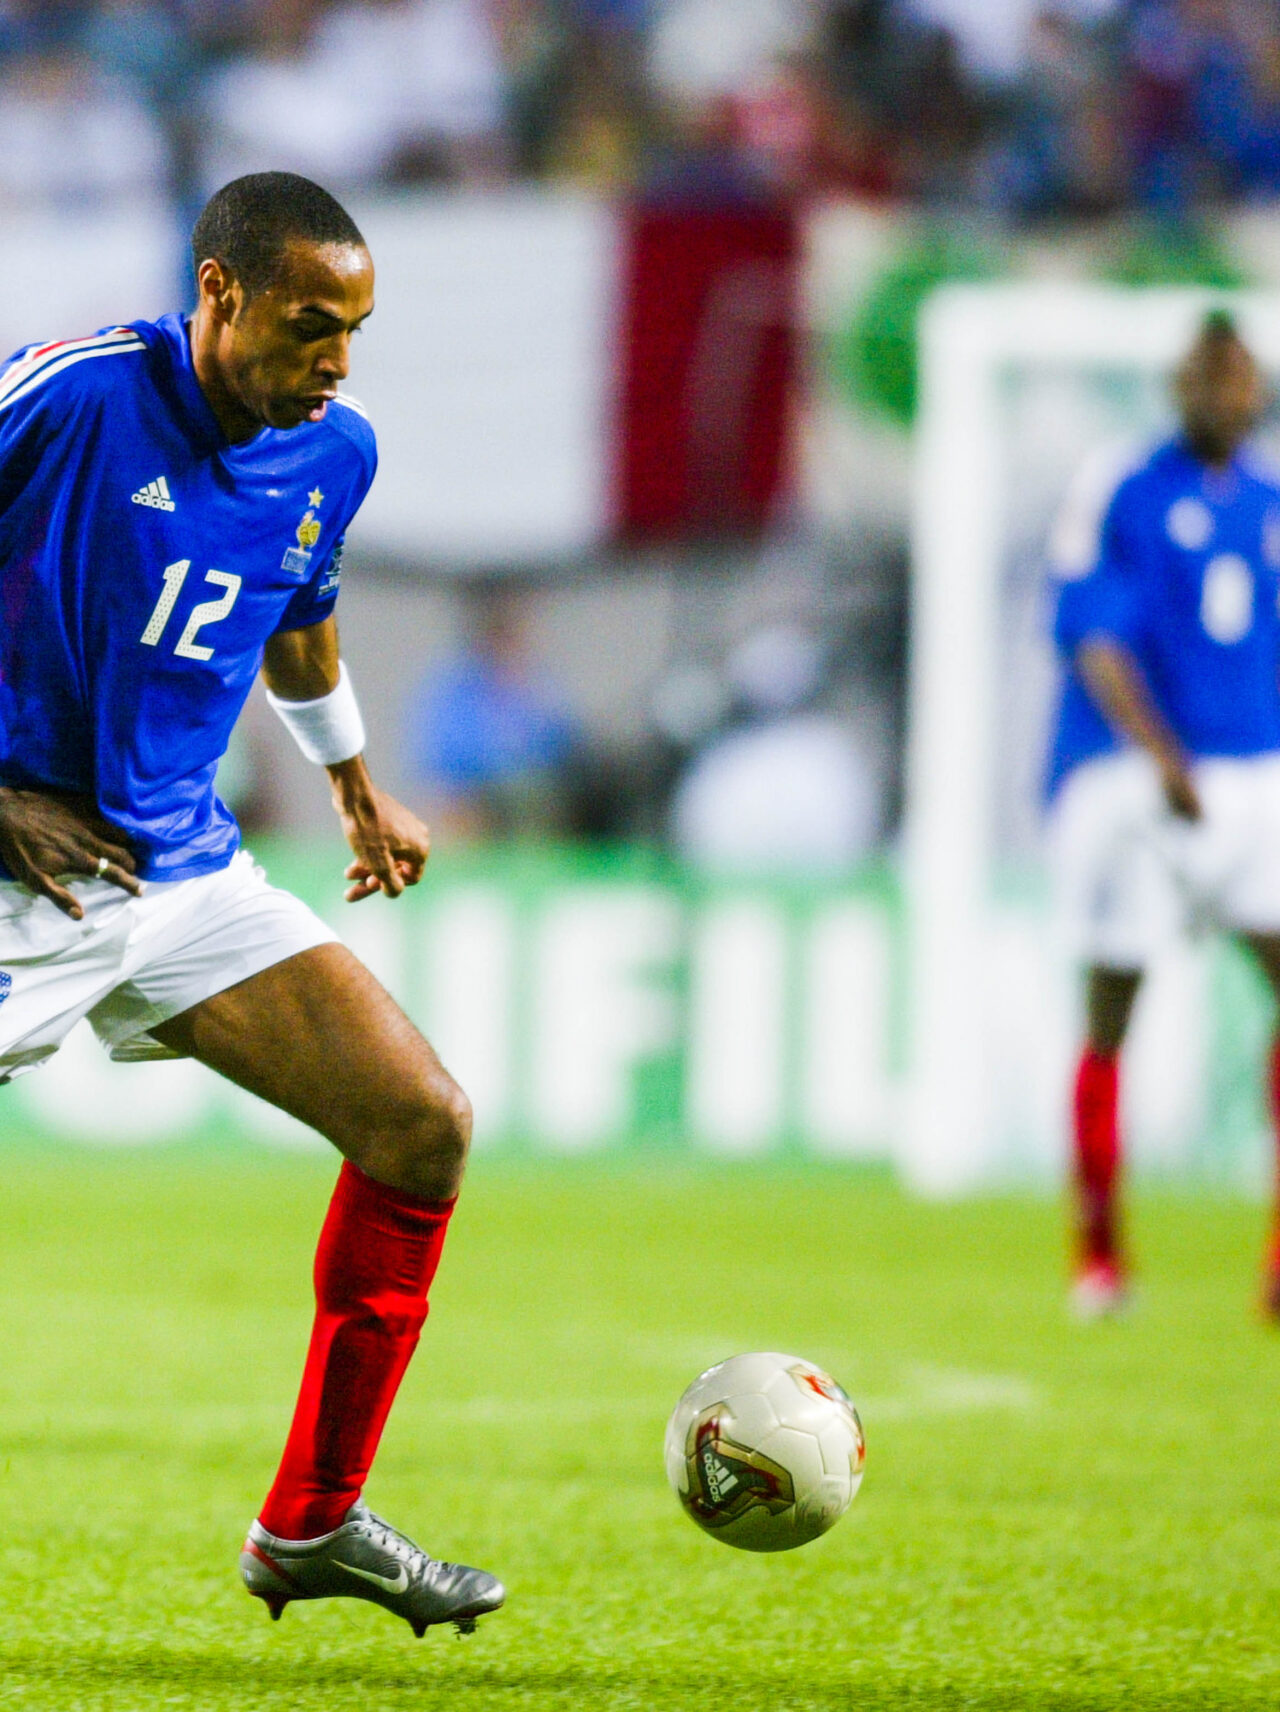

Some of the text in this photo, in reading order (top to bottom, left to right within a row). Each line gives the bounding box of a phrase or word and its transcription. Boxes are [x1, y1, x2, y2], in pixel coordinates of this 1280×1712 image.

[131, 491, 175, 512] adidas
[140, 559, 242, 661] 12
[704, 1452, 721, 1503] adidas
